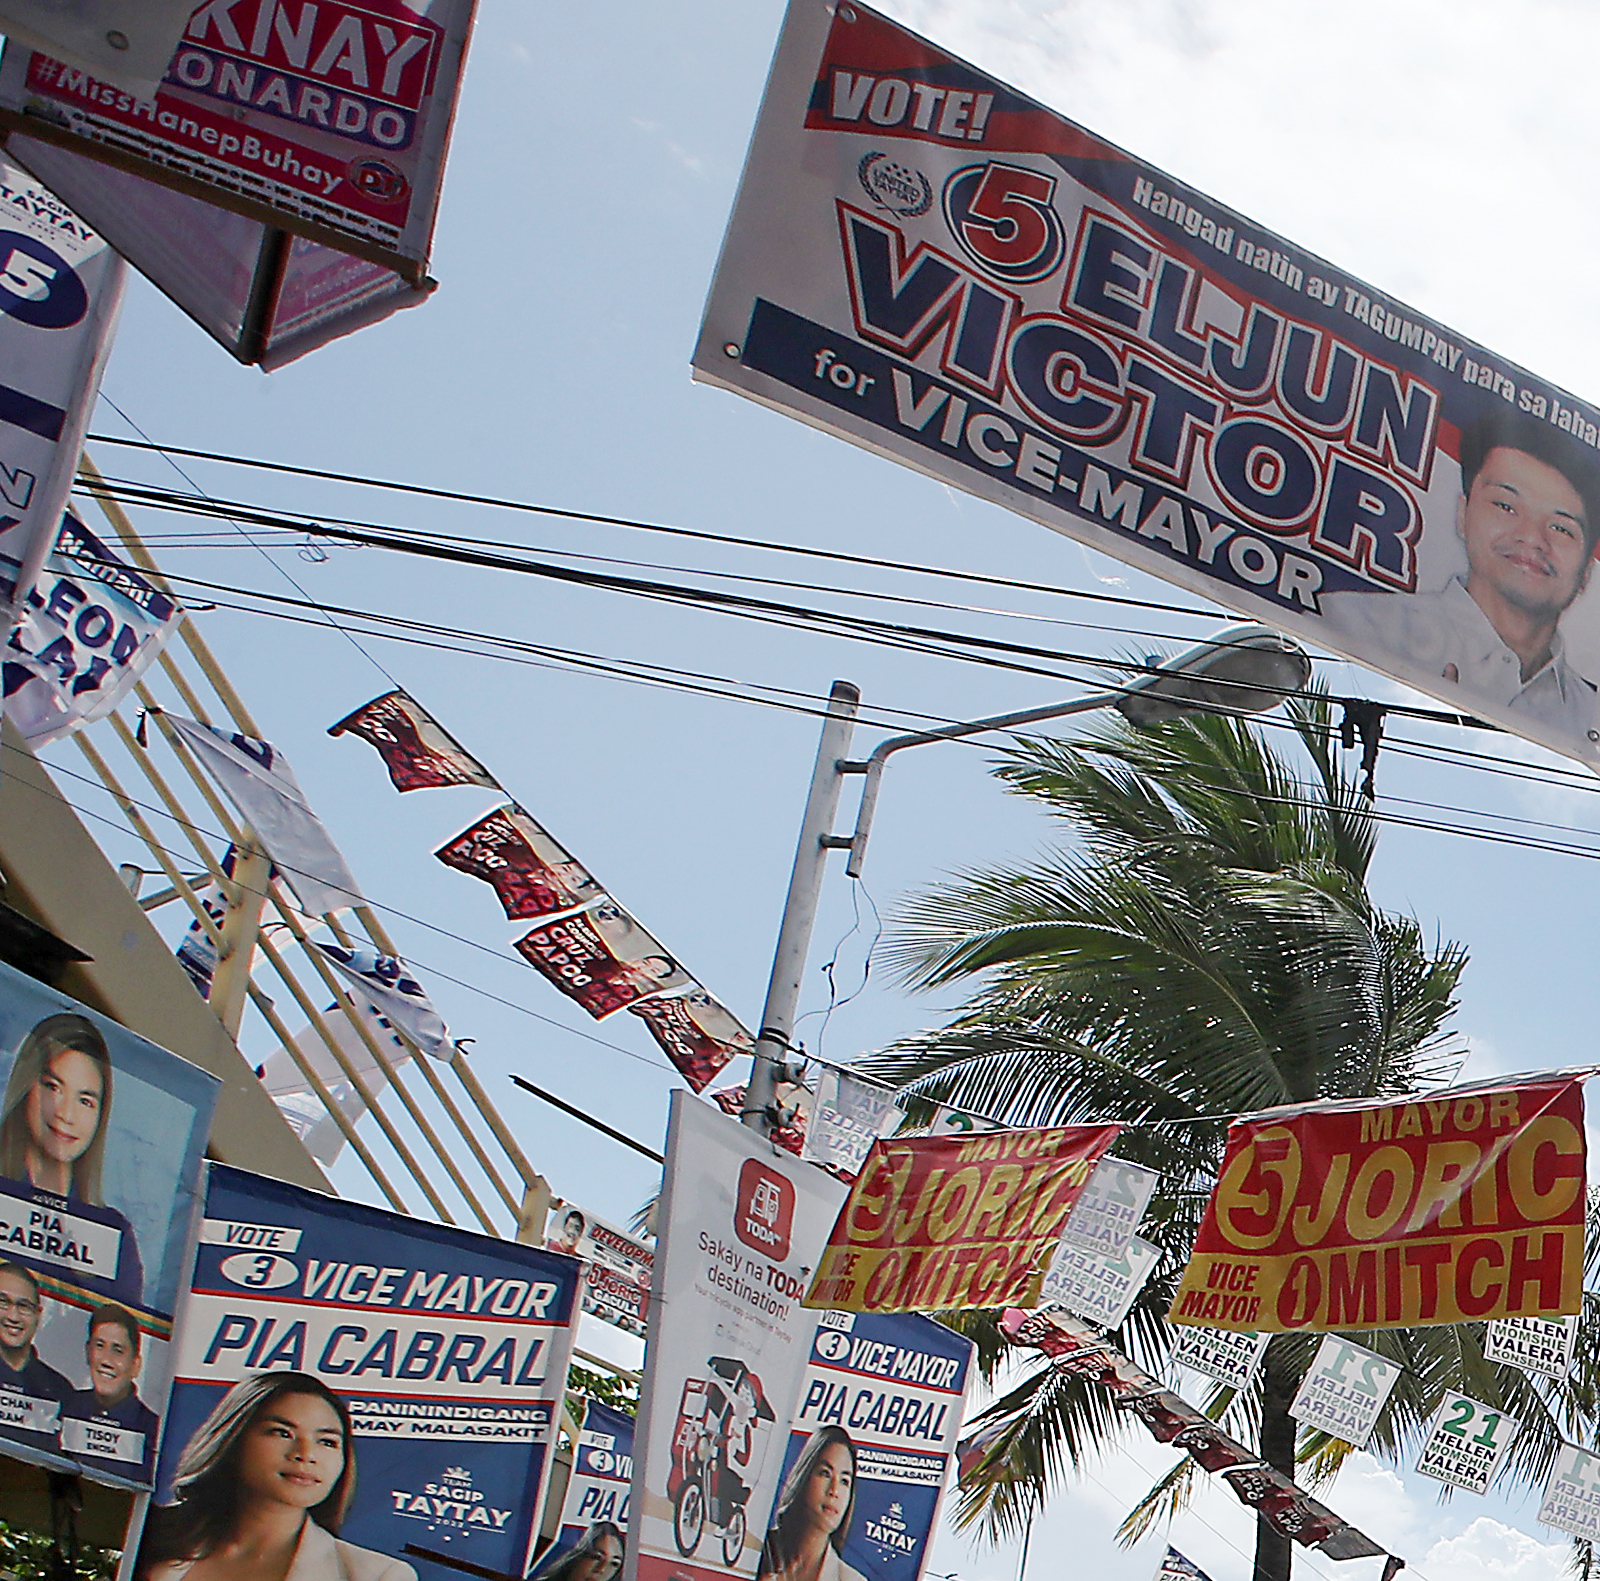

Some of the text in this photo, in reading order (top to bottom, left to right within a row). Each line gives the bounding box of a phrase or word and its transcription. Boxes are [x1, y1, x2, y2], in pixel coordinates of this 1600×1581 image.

[166, 53, 407, 146] ONARDO
[827, 71, 995, 143] VOTE!
[0, 248, 57, 302] 5
[1132, 175, 1234, 255] Hangad
[1235, 233, 1304, 288] natin
[1306, 272, 1341, 307] ay
[1341, 284, 1463, 375] TAGUMPAY
[1462, 361, 1517, 411] para
[1517, 388, 1547, 417] sa
[961, 160, 1440, 491] 5 ELJUN
[836, 199, 1423, 594] VICTOR
[814, 348, 1326, 614] for VICE-MAYOR
[1360, 1091, 1521, 1144] MAYOR
[1228, 1115, 1584, 1247] 5 JORIC
[29, 1211, 64, 1234] PIA
[226, 1223, 283, 1248] VOTE
[744, 1217, 776, 1246] TODA
[698, 1231, 743, 1272] Sakay
[744, 1261, 762, 1280] na
[1178, 1290, 1261, 1323] MAYOR
[1326, 1232, 1565, 1326] MITCH
[1206, 1262, 1260, 1292] VICE
[245, 1254, 557, 1319] 3 VICE MAYOR
[707, 1263, 790, 1323] destination!
[820, 1310, 848, 1329] VOTE
[204, 1315, 549, 1388] PIA CABRAL
[349, 1401, 547, 1426] PANININDIGANG
[352, 1419, 546, 1439] MAY MALASAKIT
[799, 1380, 951, 1442] PIA CABRAL
[1442, 1399, 1500, 1451] 21
[392, 1492, 512, 1528] TAYTAY
[426, 1483, 484, 1503] SAGIP
[865, 1520, 917, 1551] TAYTAY
